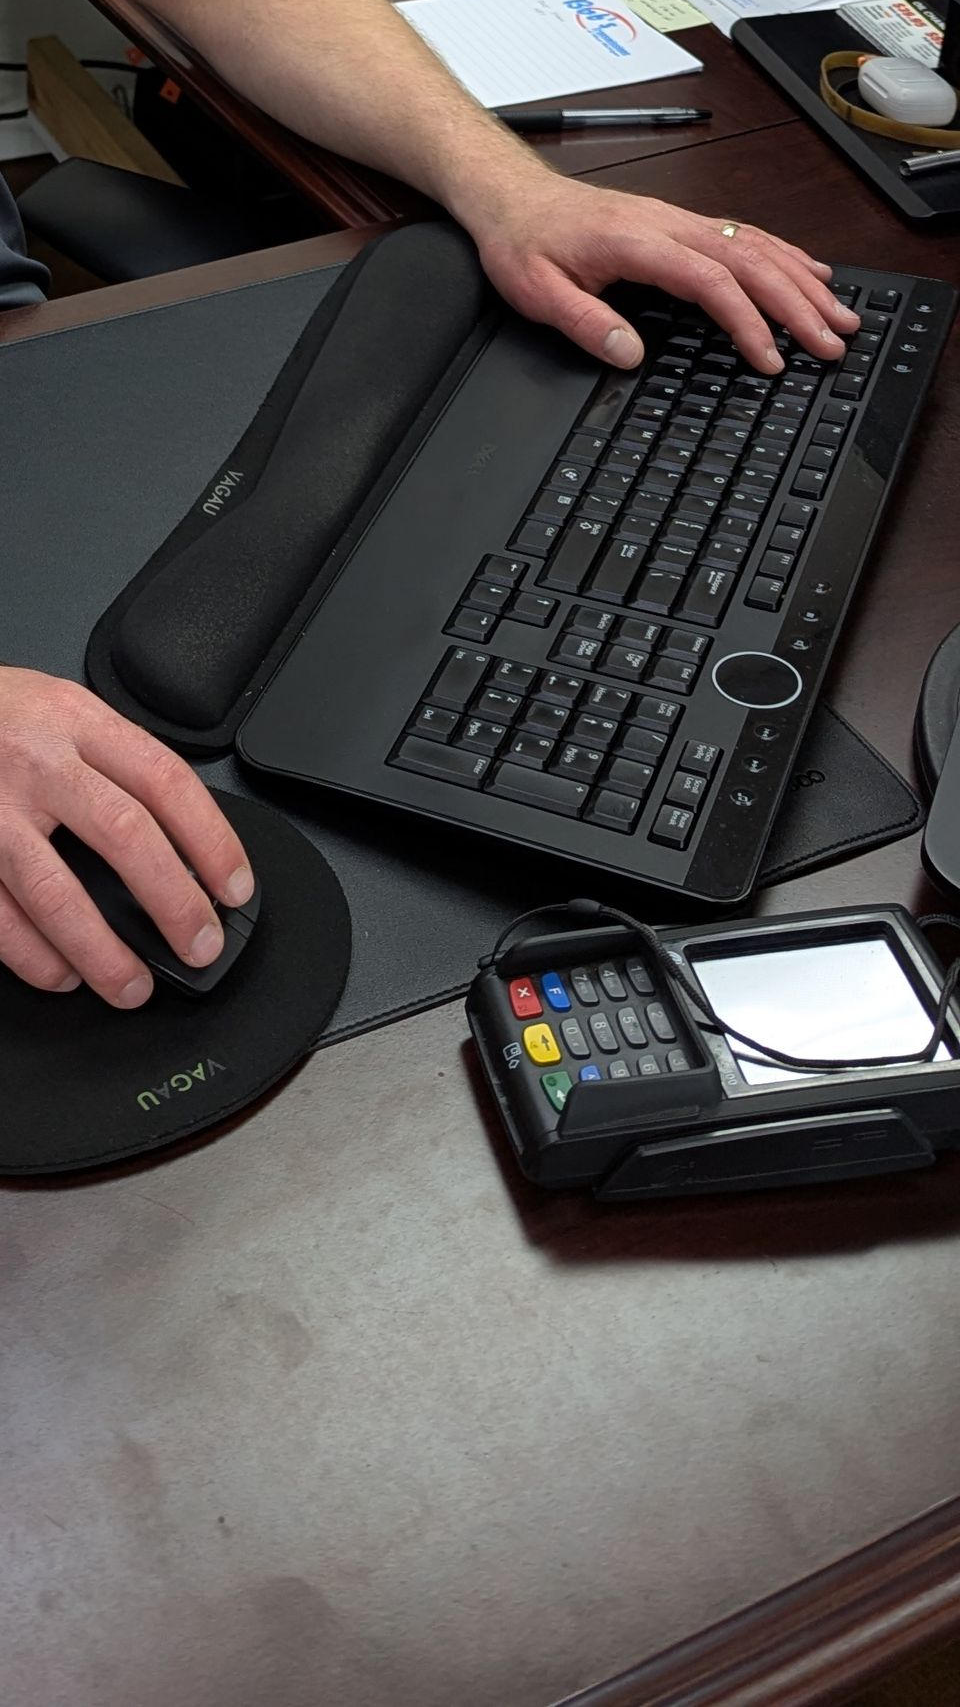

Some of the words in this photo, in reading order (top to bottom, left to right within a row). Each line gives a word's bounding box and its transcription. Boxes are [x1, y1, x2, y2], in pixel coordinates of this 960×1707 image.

[675, 367, 686, 375] V
[710, 385, 722, 393] G
[652, 408, 665, 417] N
[699, 405, 712, 414] H
[744, 409, 757, 417] Y
[641, 430, 654, 439] M
[678, 450, 691, 458] K
[713, 476, 726, 484] O
[202, 470, 244, 516] VAGAU
[703, 499, 716, 507] P
[590, 523, 602, 535] Shift
[597, 612, 612, 630] Delete
[644, 625, 658, 640] Insert
[691, 636, 706, 652] Home
[500, 662, 513, 675] End
[680, 667, 692, 680] End
[567, 679, 580, 687] 4
[592, 686, 607, 703] Home
[616, 691, 627, 700] 7
[506, 696, 519, 704] 2
[553, 709, 565, 717] 5
[656, 702, 668, 715] Lock
[665, 705, 677, 718] Num
[422, 708, 435, 720] Del
[602, 721, 614, 729] 8
[491, 726, 503, 734] 3
[539, 740, 550, 748] 6
[564, 746, 579, 764] PgUp
[588, 753, 600, 761] 9
[472, 758, 487, 775] Enter
[667, 809, 679, 827] Break
[678, 812, 690, 829] Pause
[602, 969, 616, 978] 4
[630, 965, 643, 973] 1
[574, 973, 589, 982] 7
[548, 987, 562, 995] F
[650, 1011, 664, 1019] 2
[622, 1016, 635, 1024] 5
[593, 1021, 606, 1029] 8
[565, 1026, 578, 1034] 0
[672, 1057, 685, 1066] 3
[642, 1063, 656, 1072] 6
[613, 1068, 627, 1077] 9
[136, 1058, 227, 1111] VAGAU
